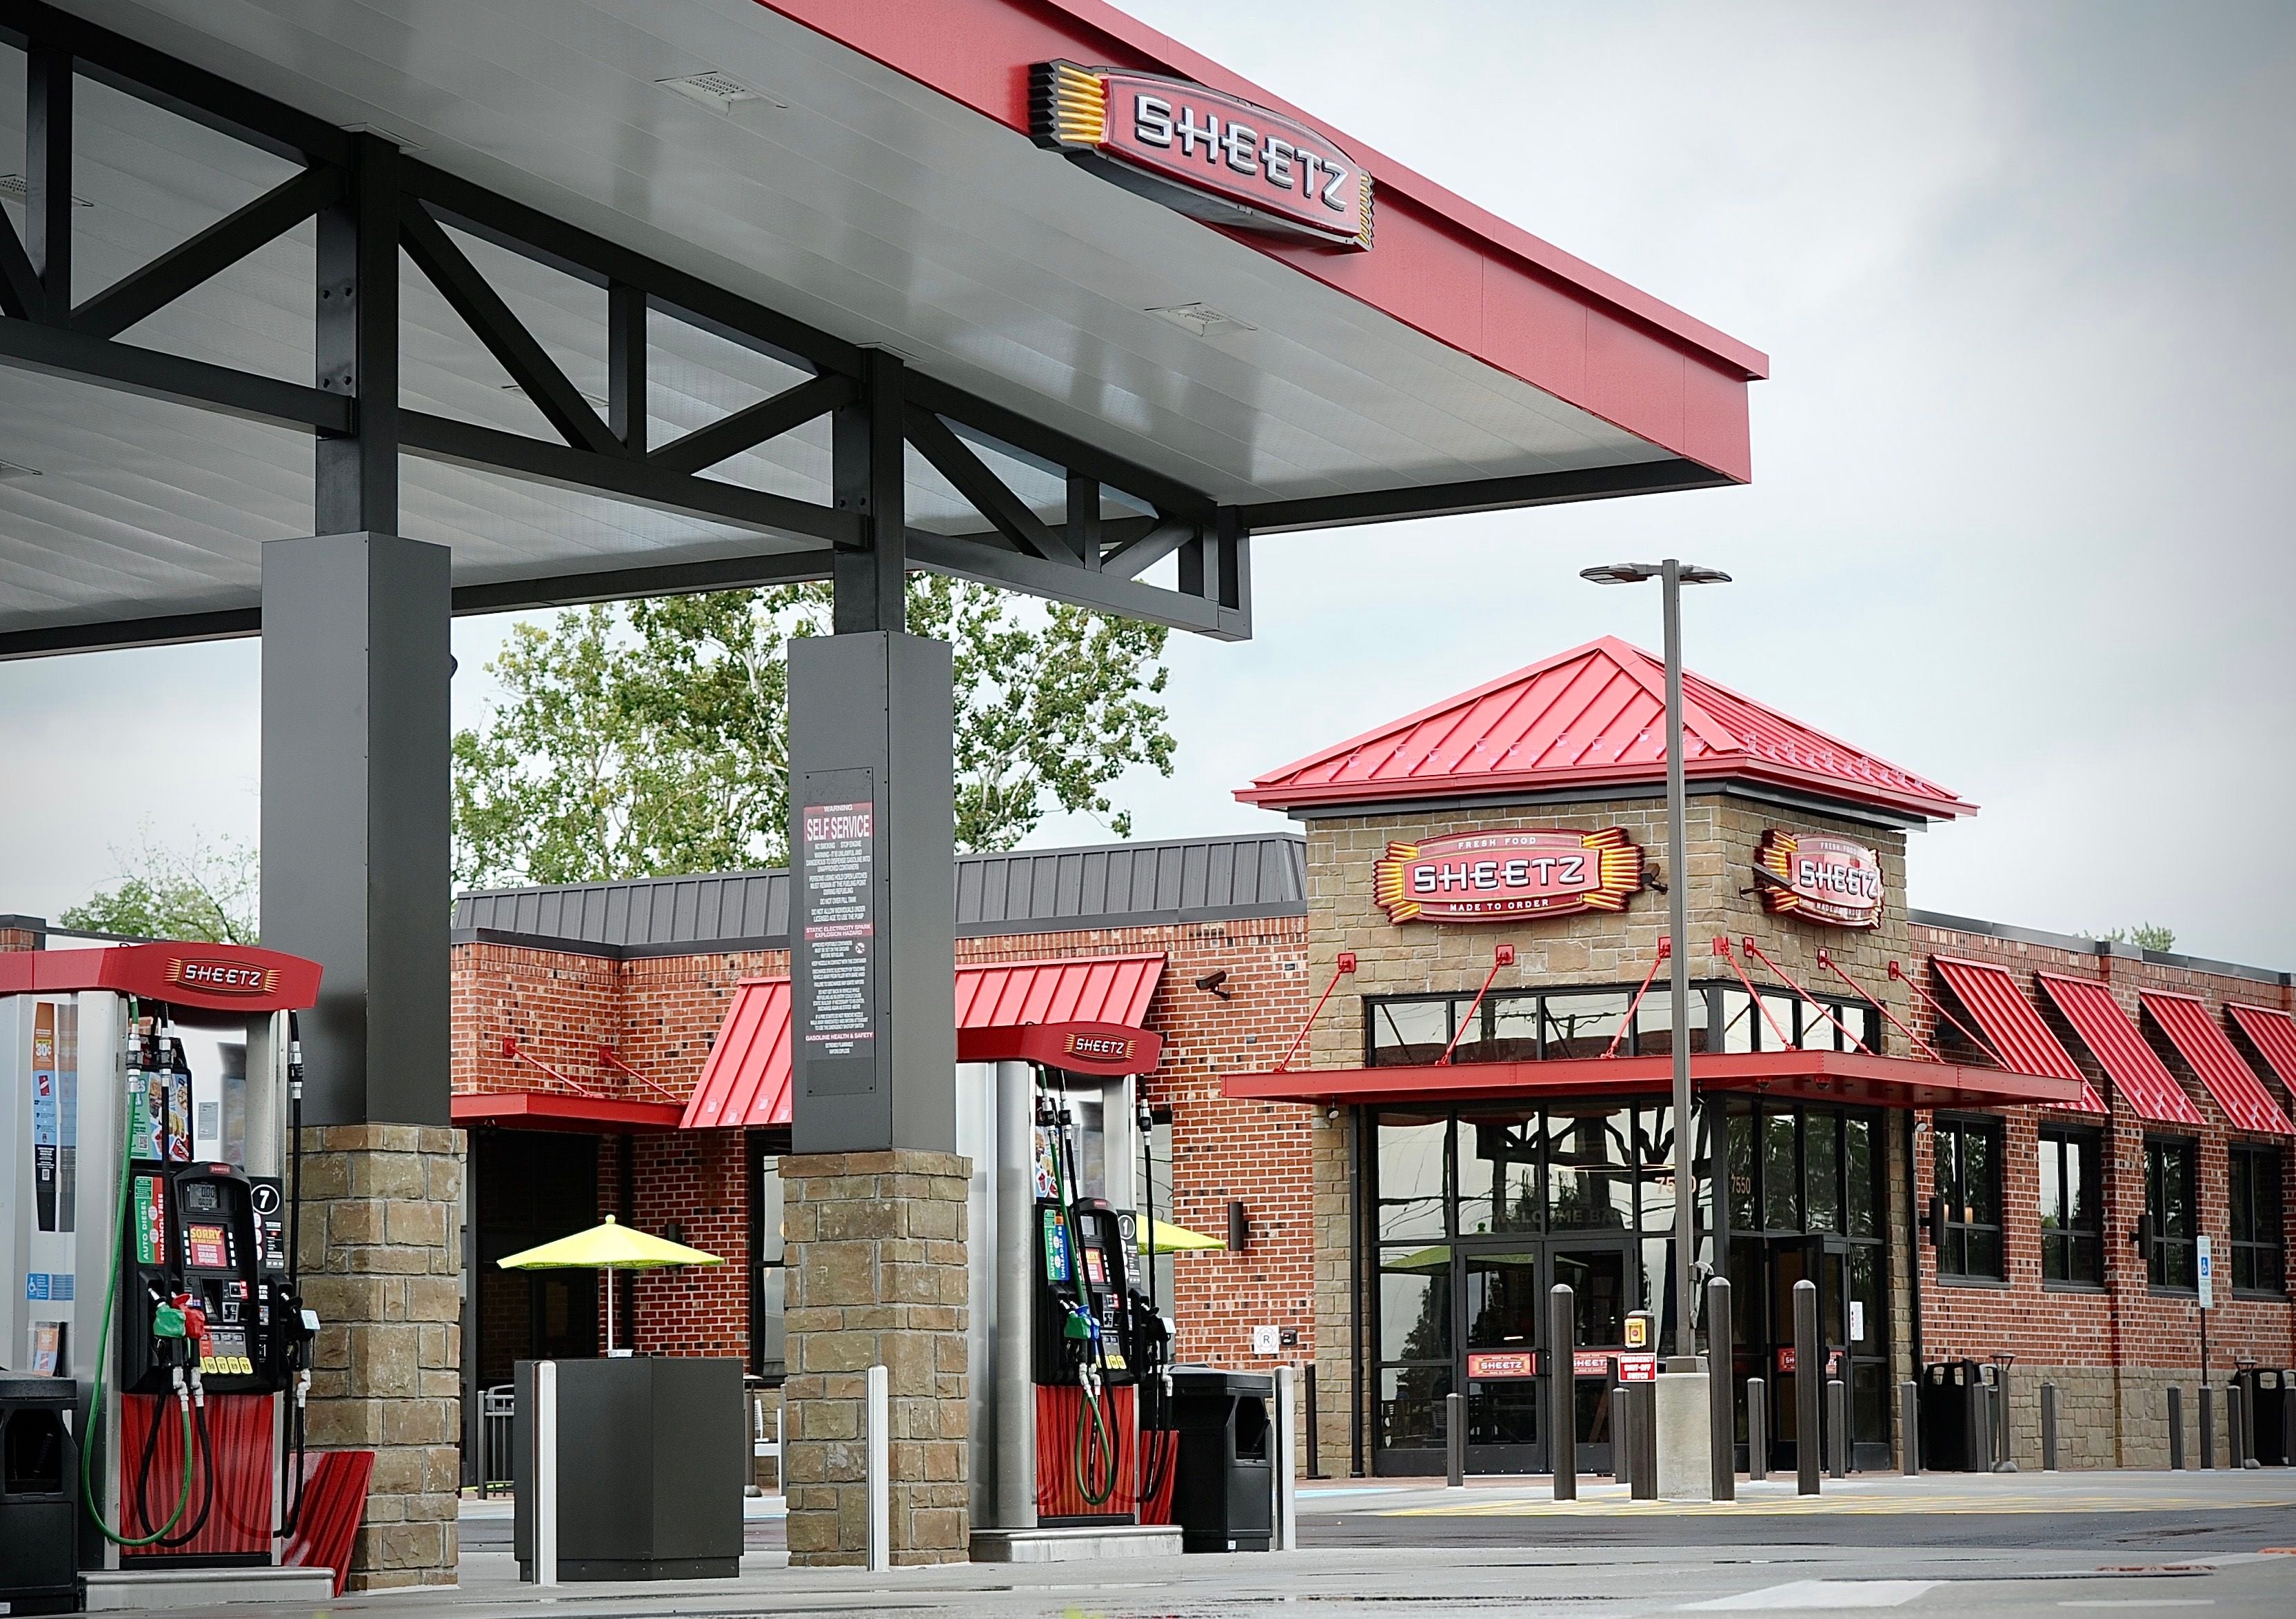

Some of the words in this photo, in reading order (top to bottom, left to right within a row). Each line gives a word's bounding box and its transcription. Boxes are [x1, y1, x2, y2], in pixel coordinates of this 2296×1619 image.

[1135, 94, 1349, 211] SHEETZ
[823, 804, 853, 812] WARNING
[807, 817, 829, 841] SELF
[831, 814, 869, 840] SERVICE
[1458, 838, 1496, 849] FRESH
[1504, 836, 1536, 845] FOOD
[1820, 841, 1840, 850] FRESH
[1413, 856, 1584, 894] SHEETZ
[1800, 859, 1877, 900] SHEETZ
[1449, 903, 1481, 912] MADE
[1487, 903, 1502, 911] TO
[1507, 898, 1549, 909] ORDER
[184, 964, 261, 986] SHEETZ
[1076, 1038, 1125, 1054] SHEETZ
[1655, 1176, 1696, 1194] 750
[1731, 1175, 1751, 1194] 7550
[259, 1189, 270, 1209] 7
[190, 1227, 221, 1240] SORRY
[1122, 1219, 1129, 1236] 1
[1263, 1335, 1270, 1344] R
[1480, 1361, 1523, 1369] SHEETZ
[1573, 1359, 1607, 1367] HEET
